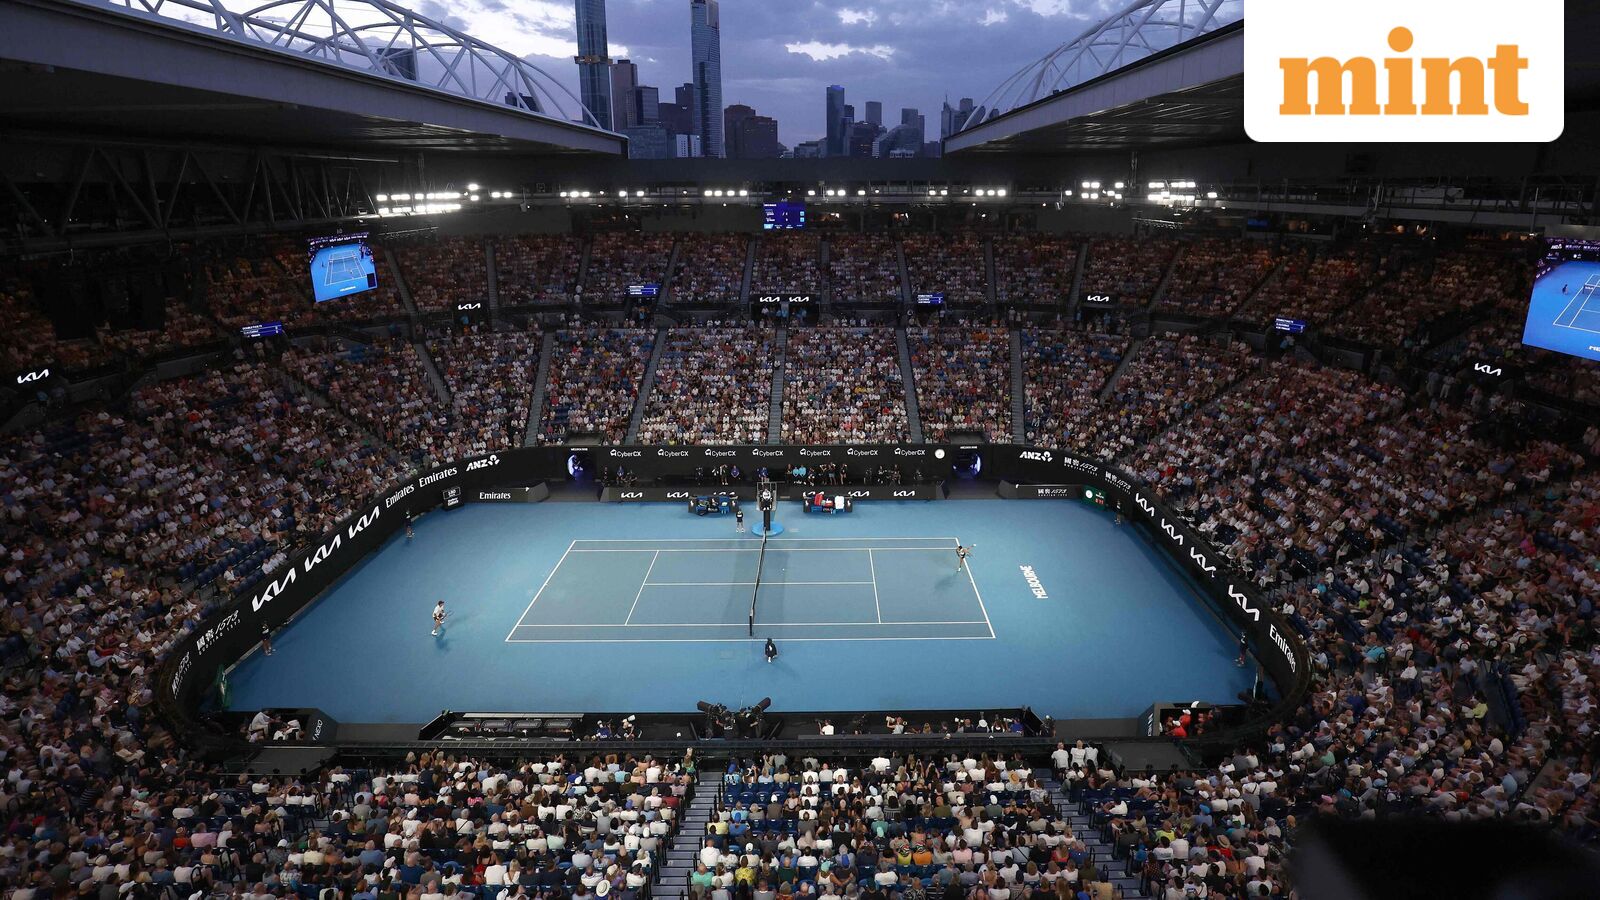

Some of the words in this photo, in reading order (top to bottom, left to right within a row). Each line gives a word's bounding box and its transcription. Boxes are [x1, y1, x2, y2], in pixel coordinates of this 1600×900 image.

[1019, 451, 1042, 461] ANZ
[466, 459, 488, 472] ANZ
[418, 466, 458, 488] Emirates
[385, 484, 415, 509] Emirates
[479, 491, 511, 500] Emirates
